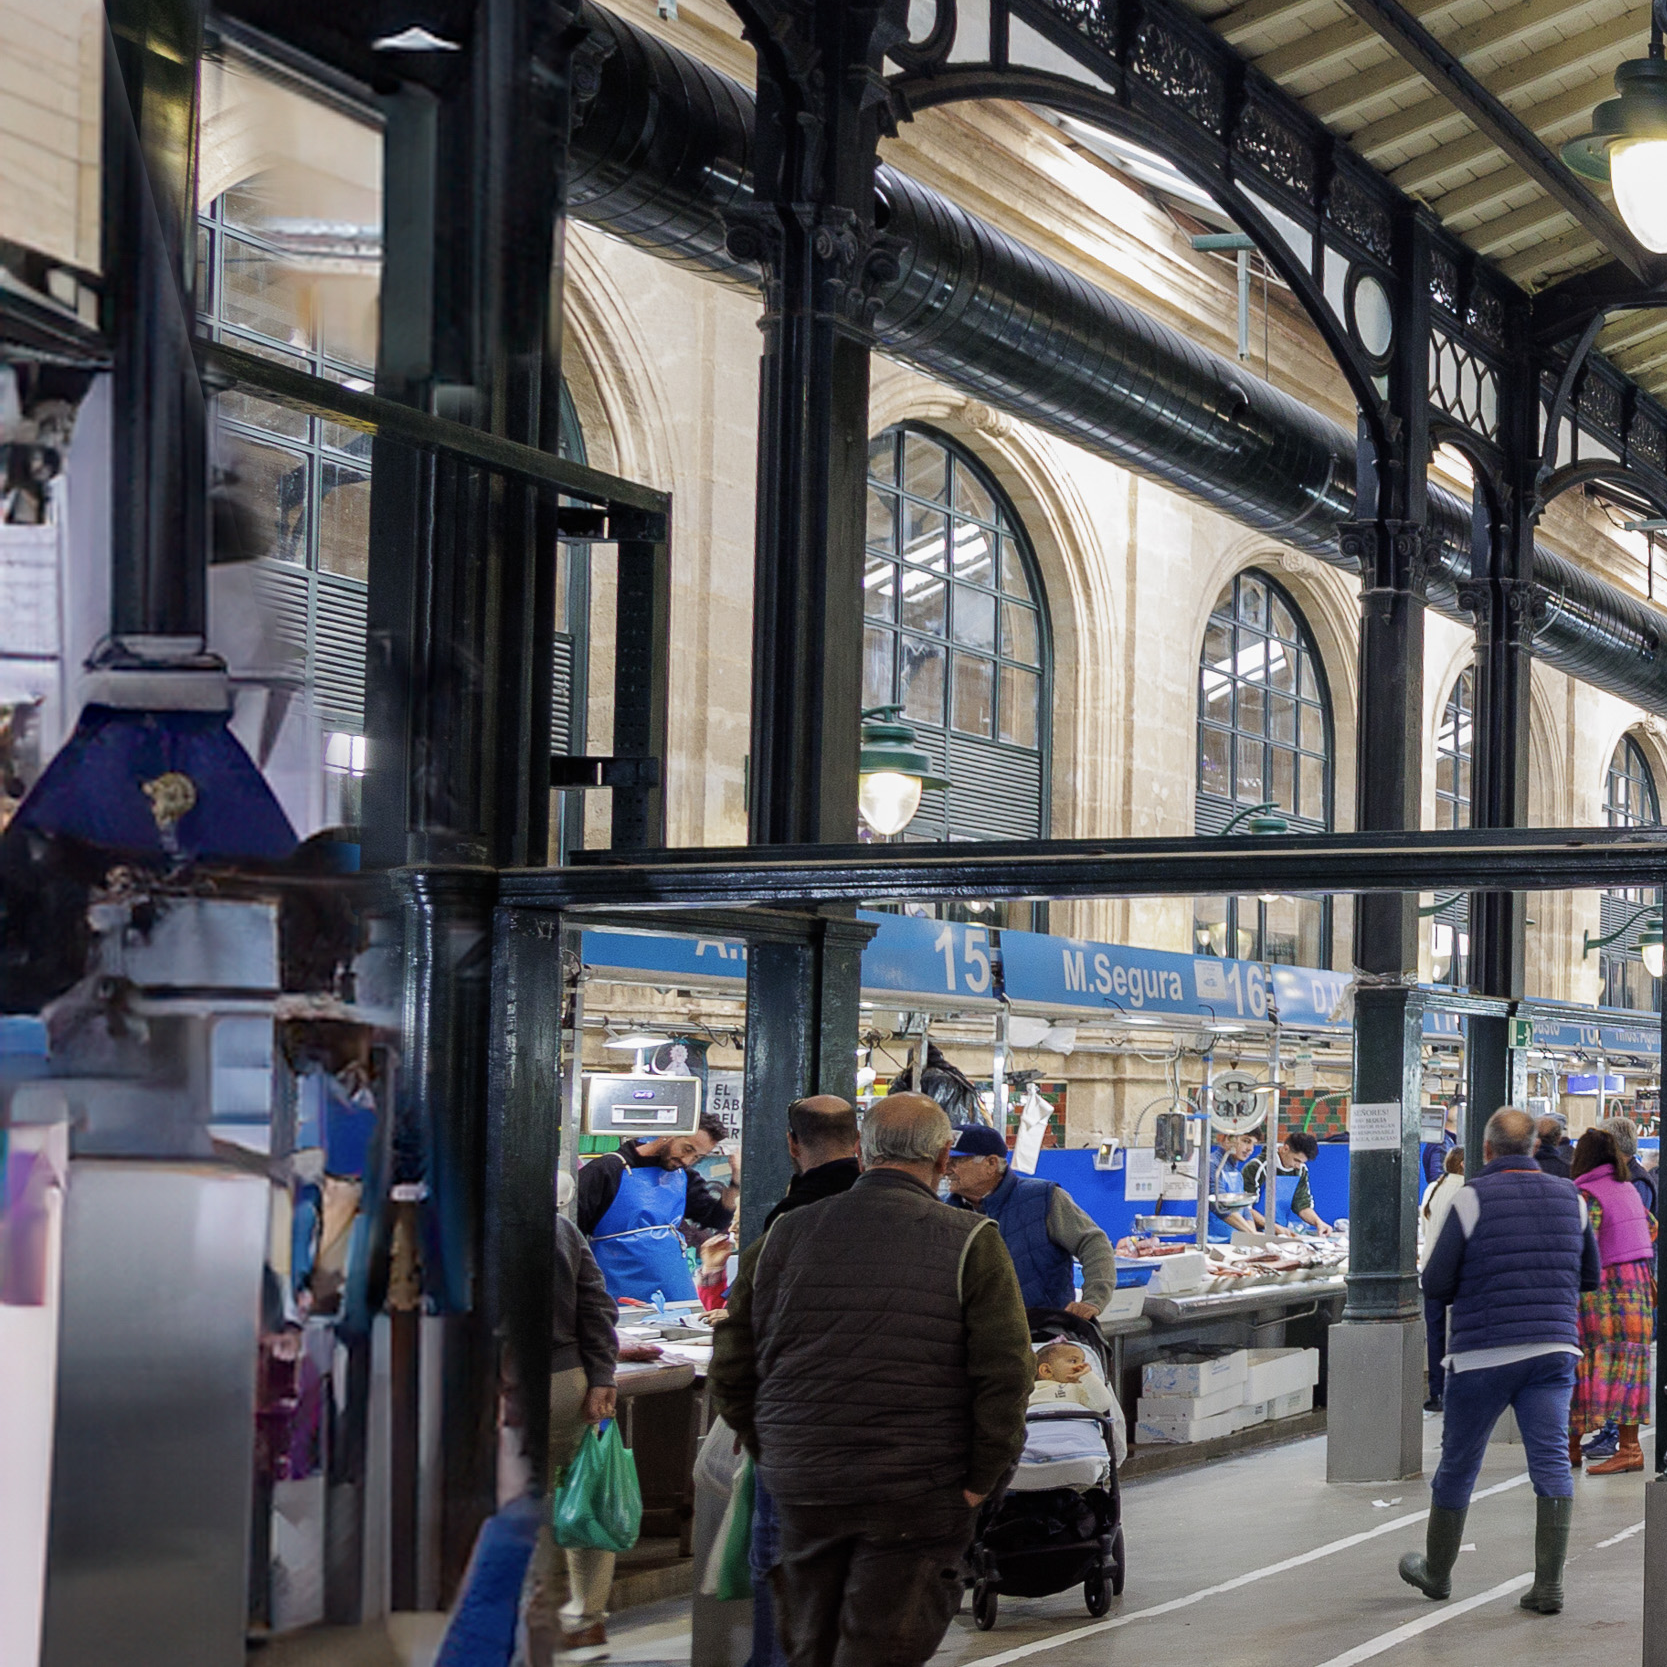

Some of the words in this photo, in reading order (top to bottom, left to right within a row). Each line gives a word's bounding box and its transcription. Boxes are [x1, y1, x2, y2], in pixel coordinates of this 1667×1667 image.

[935, 925, 991, 993] 15
[1062, 949, 1183, 1008] M.Segura
[1228, 963, 1267, 1018] 16
[713, 1098, 743, 1111] SAB
[714, 1083, 731, 1096] EL
